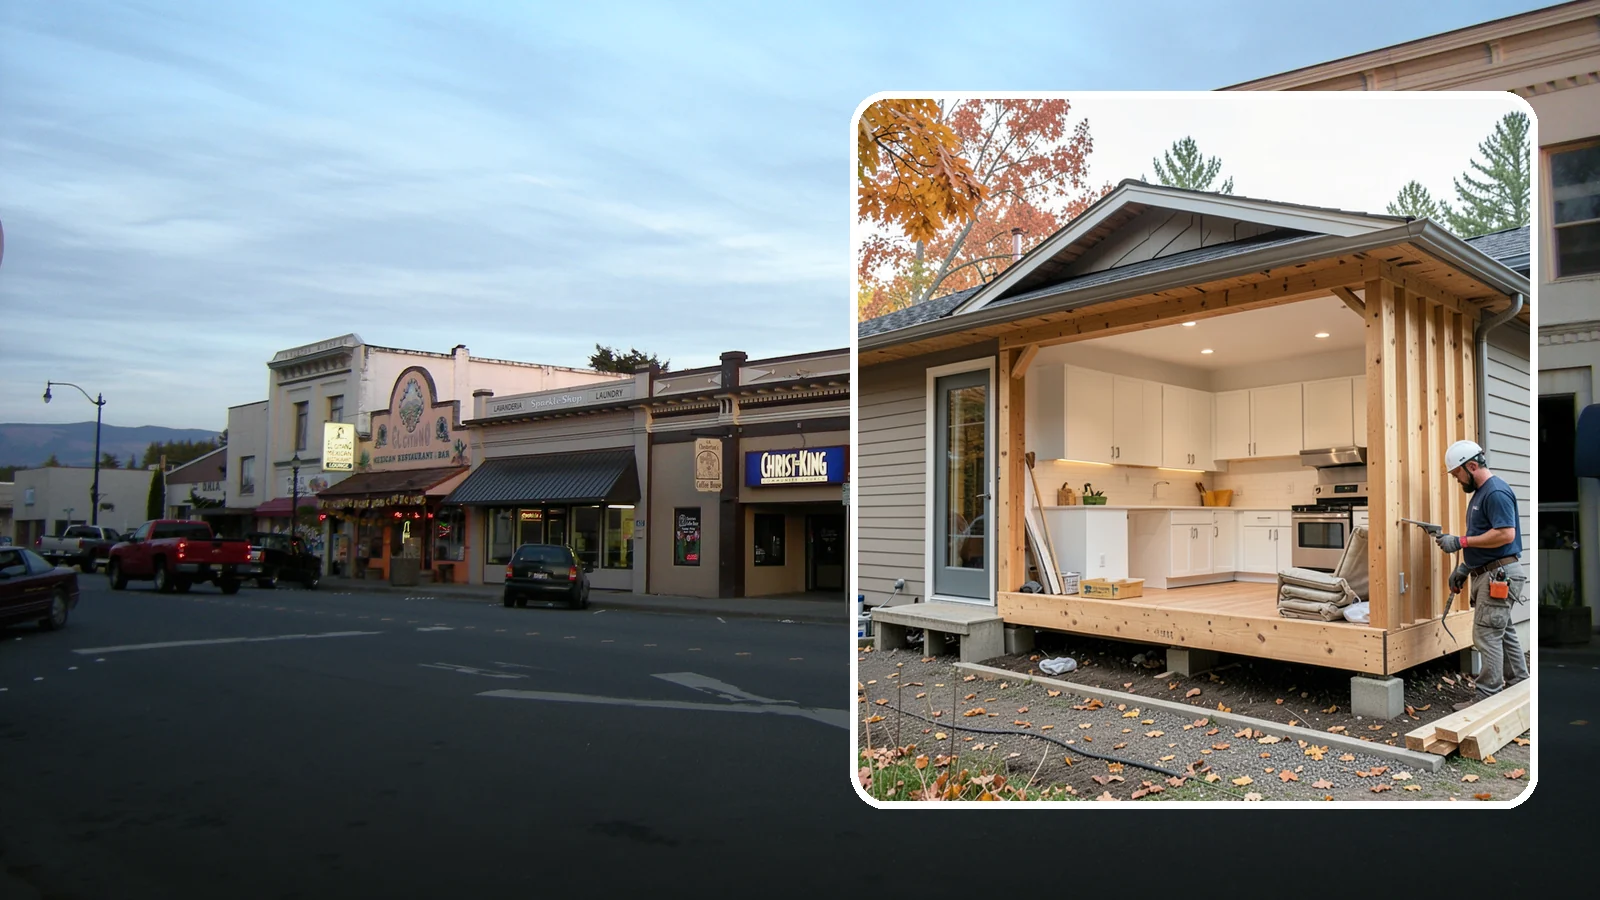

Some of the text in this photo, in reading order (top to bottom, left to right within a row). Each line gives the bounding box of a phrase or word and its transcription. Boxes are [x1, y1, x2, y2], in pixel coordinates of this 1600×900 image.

[531, 394, 582, 409] Sparkle Shop
[595, 389, 623, 400] LAUNDRY
[493, 402, 522, 413] LAVANDERIA
[374, 455, 396, 464] MEXICAN
[397, 451, 433, 462] RESTAURANT
[437, 450, 450, 459] BAR
[761, 450, 827, 478] CHRIST KING
